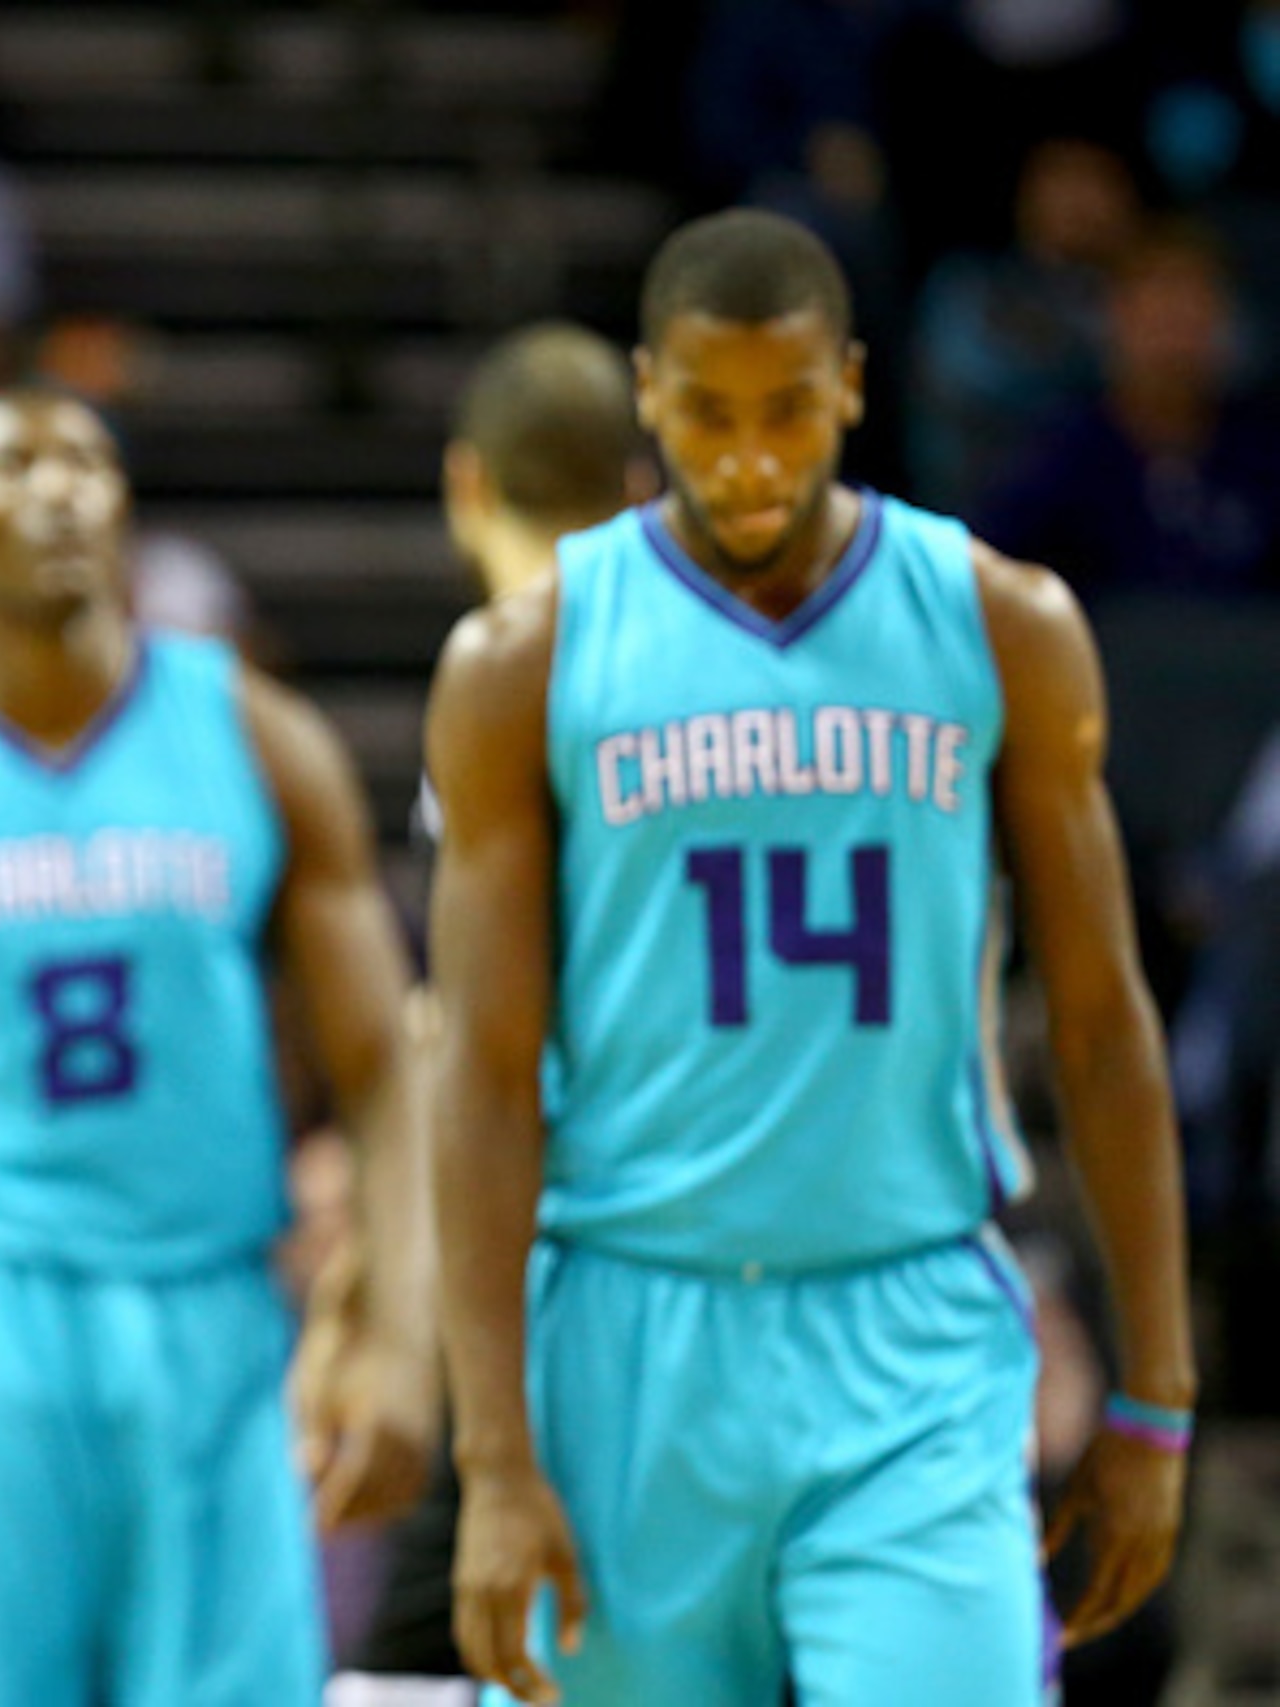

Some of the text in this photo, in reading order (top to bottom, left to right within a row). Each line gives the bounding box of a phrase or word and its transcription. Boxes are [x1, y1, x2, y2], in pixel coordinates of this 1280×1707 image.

[596, 704, 968, 828] CHARLOTTE
[686, 842, 892, 1028] 14
[30, 956, 144, 1106] 8
